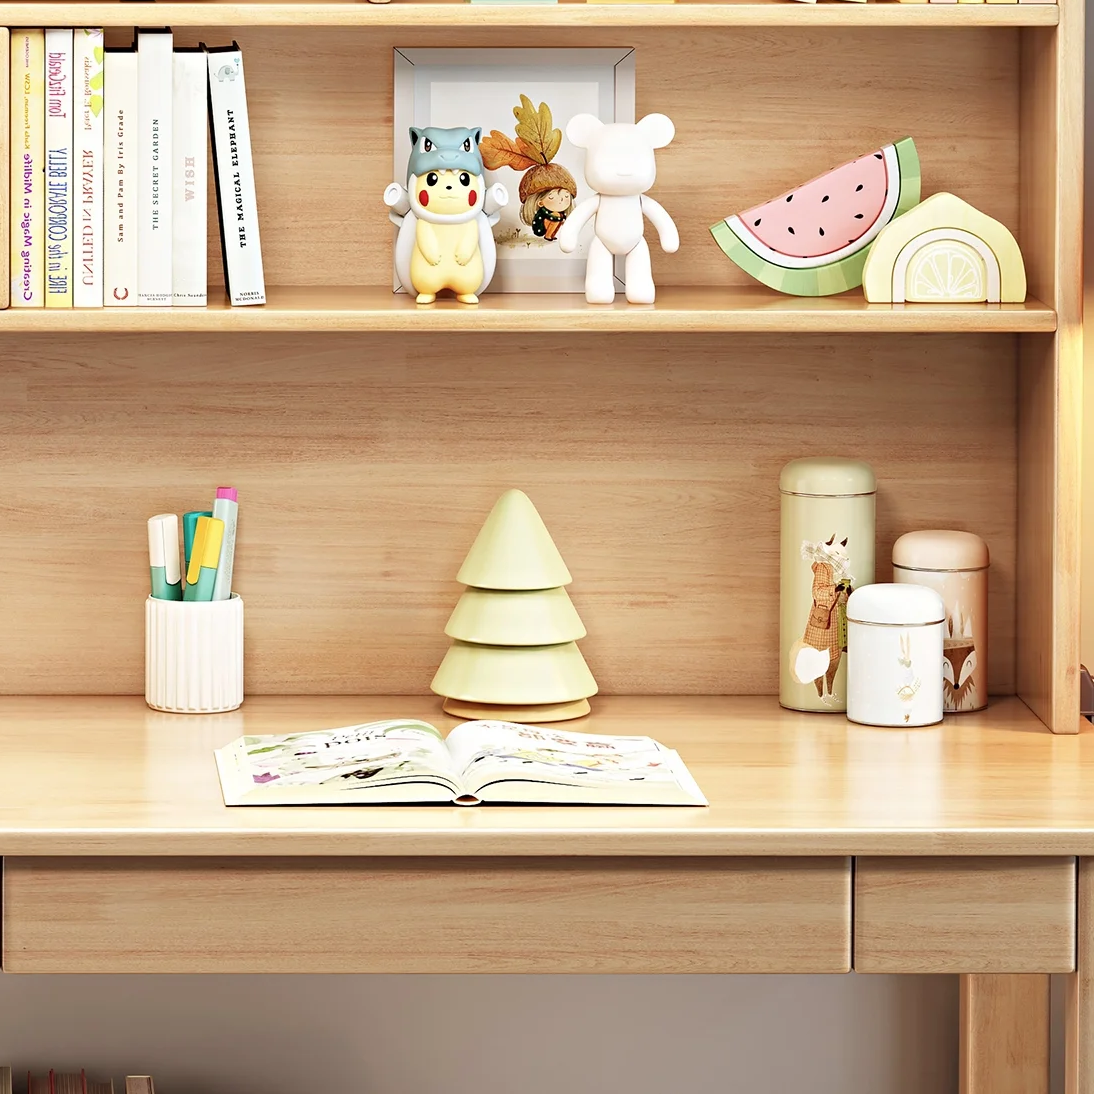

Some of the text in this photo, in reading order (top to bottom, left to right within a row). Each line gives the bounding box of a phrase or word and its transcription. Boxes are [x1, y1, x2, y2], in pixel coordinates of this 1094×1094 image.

[117, 163, 125, 175] By
[184, 156, 195, 202] WISH
[226, 109, 247, 248] THE MAGICAL ELEPHANT
